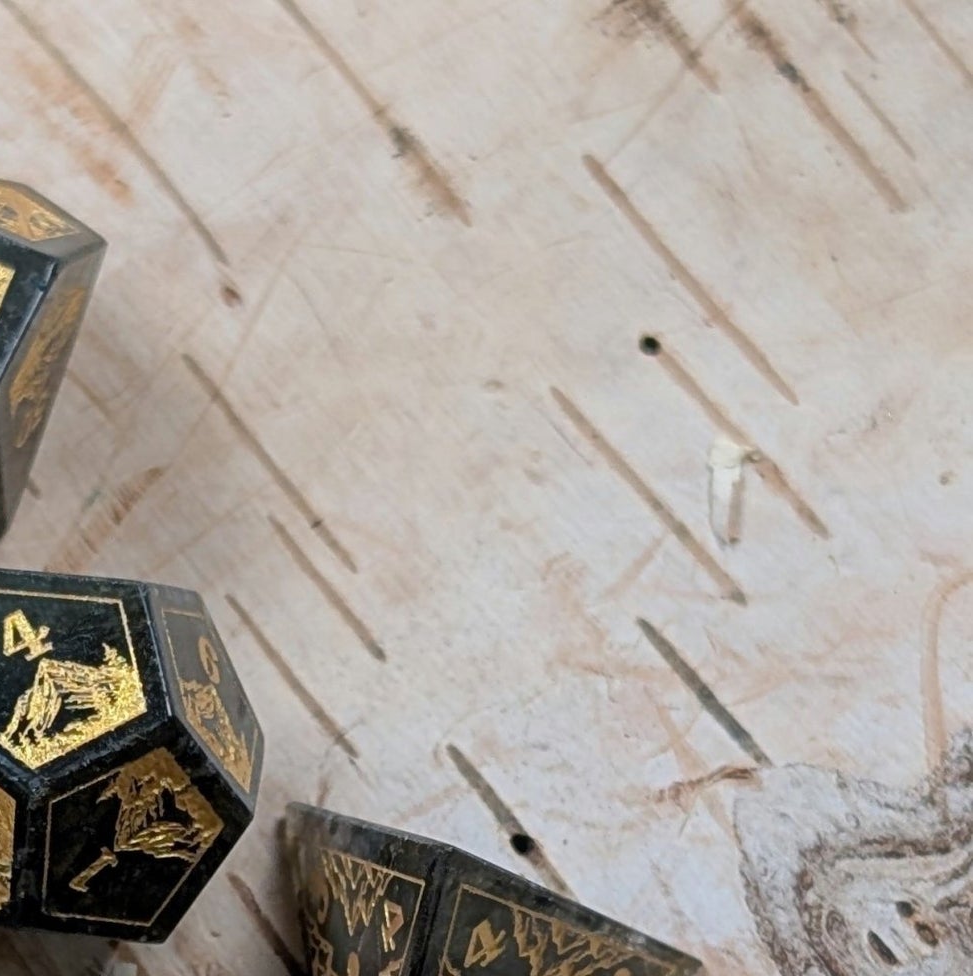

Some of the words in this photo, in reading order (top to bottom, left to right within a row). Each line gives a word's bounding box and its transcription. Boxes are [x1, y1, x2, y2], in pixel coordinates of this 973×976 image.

[3, 610, 52, 661] 4
[69, 847, 118, 892] 1
[381, 900, 404, 952] 4
[464, 918, 506, 968] 4
